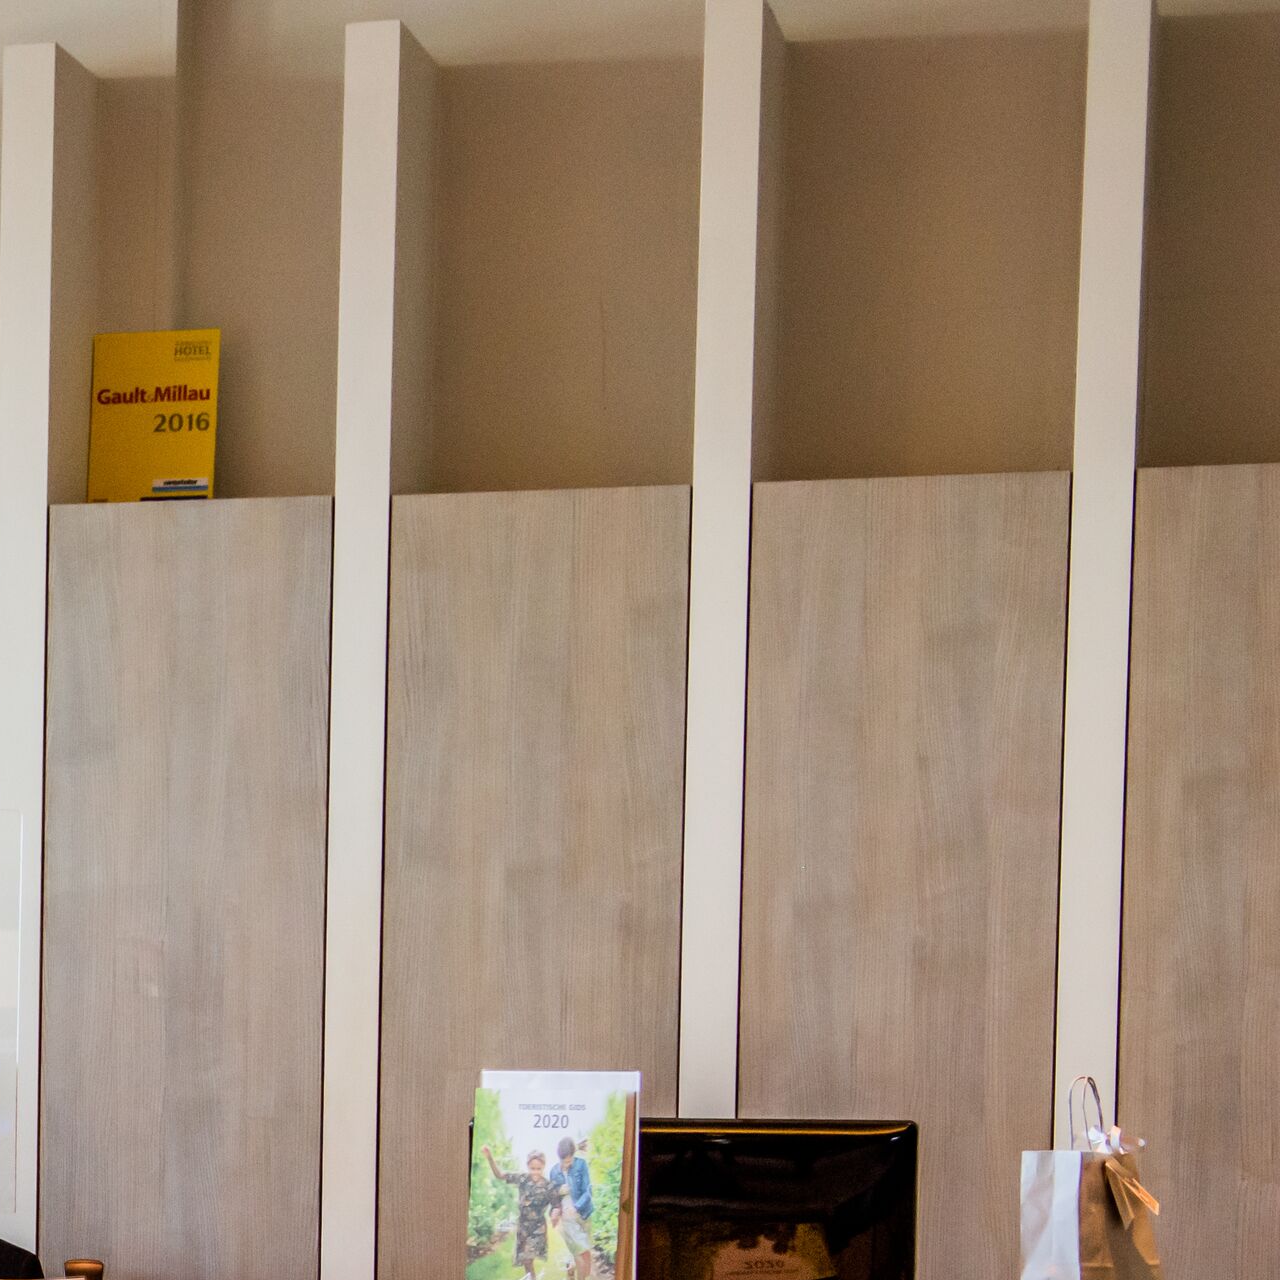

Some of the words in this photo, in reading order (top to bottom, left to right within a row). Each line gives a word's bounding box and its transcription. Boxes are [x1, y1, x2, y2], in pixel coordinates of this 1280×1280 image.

[174, 345, 211, 357] HOTEL
[153, 412, 210, 432] 2016
[533, 1114, 569, 1128] 2020
